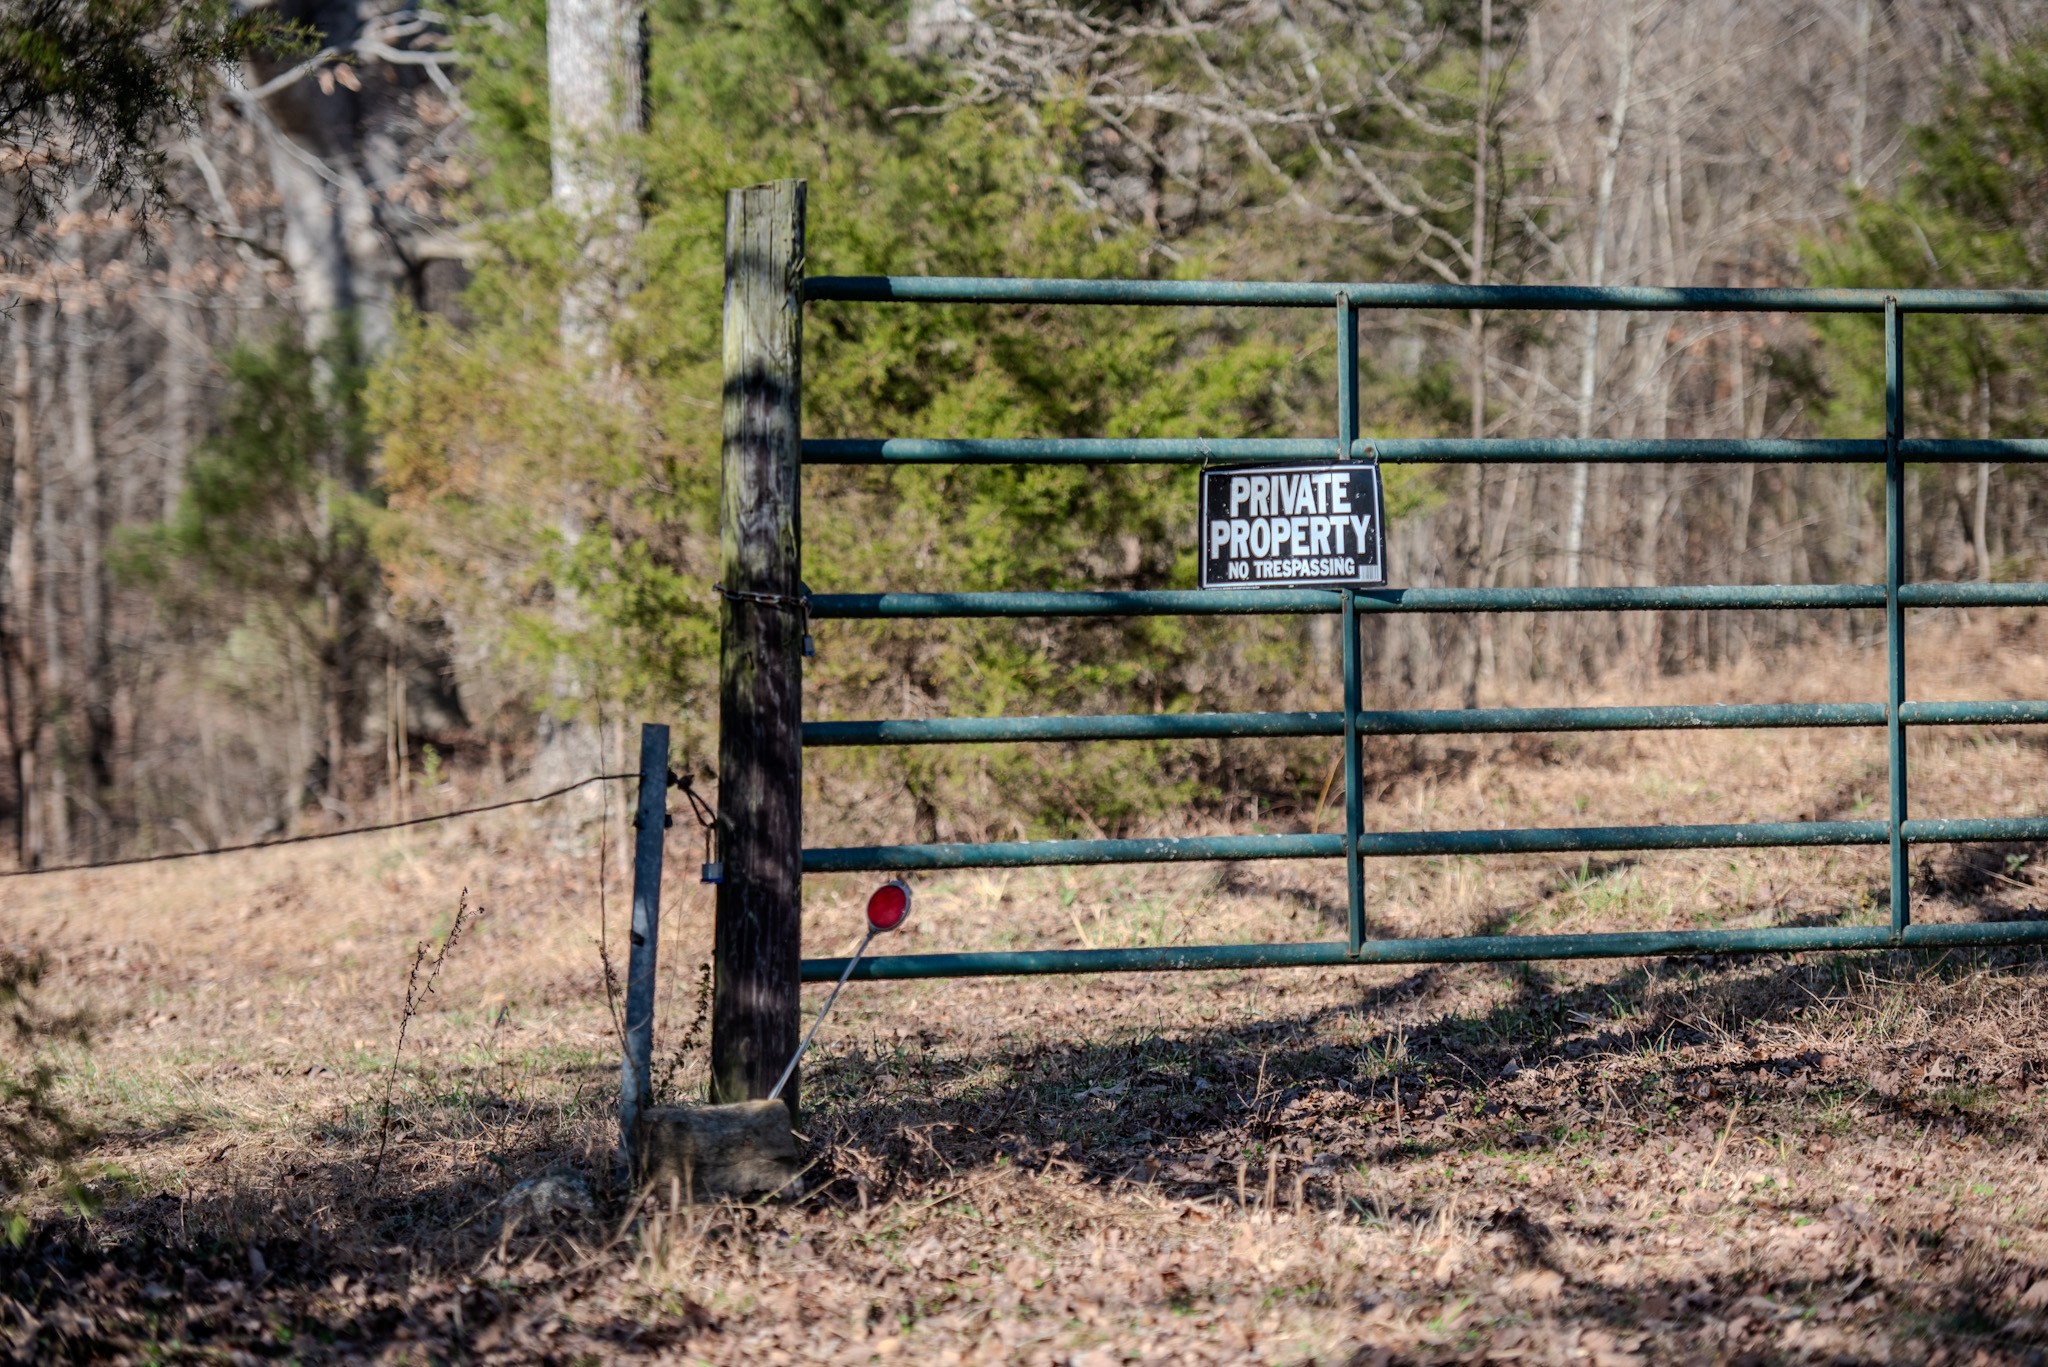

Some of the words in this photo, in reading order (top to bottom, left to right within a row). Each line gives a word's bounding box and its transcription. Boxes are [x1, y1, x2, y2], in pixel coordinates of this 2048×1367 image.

[1230, 472, 1352, 518] PRIVATE
[1210, 514, 1371, 560] PROPERTY
[1228, 560, 1249, 580] NO
[1253, 557, 1355, 579] TRESPASSING
